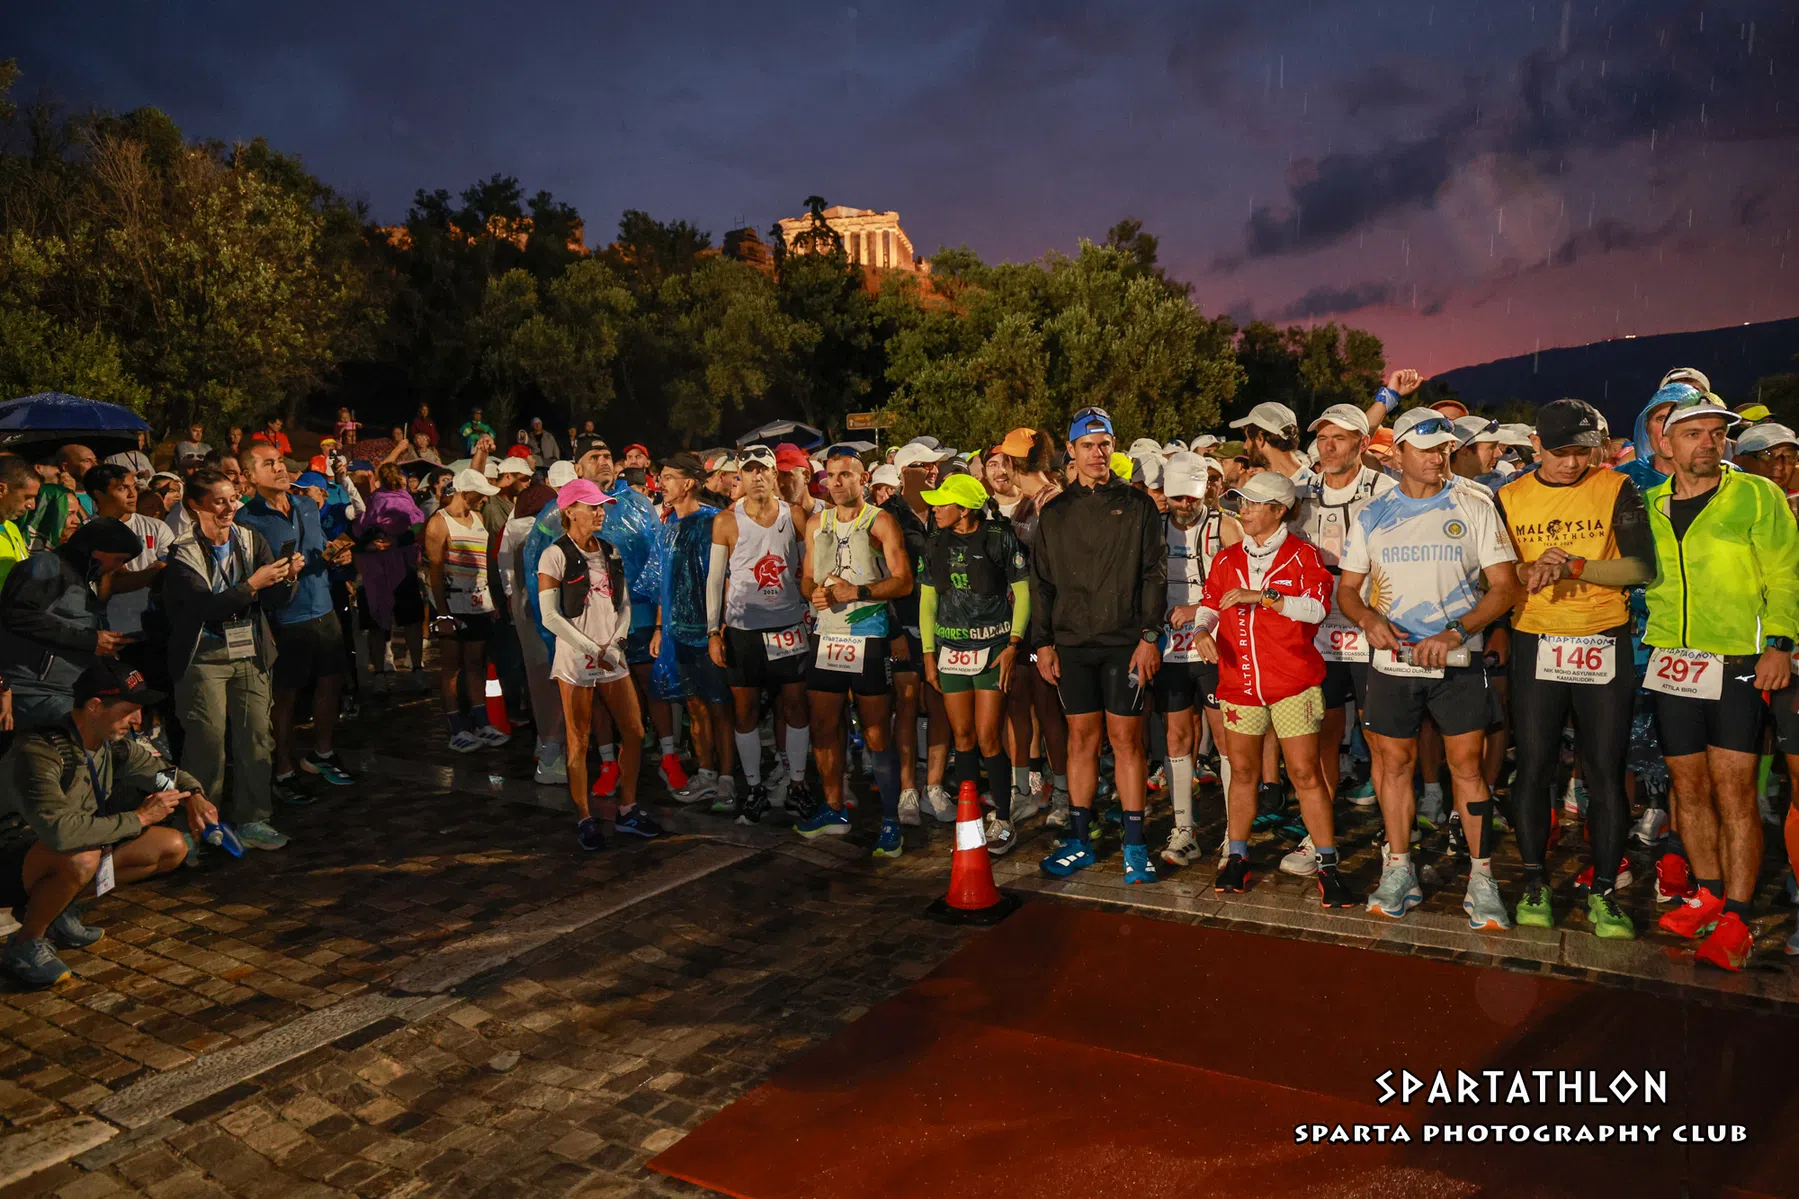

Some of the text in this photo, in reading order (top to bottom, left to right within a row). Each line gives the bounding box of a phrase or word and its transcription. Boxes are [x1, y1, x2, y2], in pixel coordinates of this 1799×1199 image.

[1516, 519, 1604, 536] MALYSIA
[1517, 531, 1605, 543] SPARTATHLON
[1382, 544, 1463, 563] ARGENTINA
[772, 628, 804, 648] 191
[1330, 630, 1358, 650] 92
[826, 642, 856, 663] 173
[947, 650, 979, 665] 361
[1238, 607, 1253, 696] ALTRA RUNN
[1552, 645, 1602, 670] 146
[1657, 656, 1709, 683] 297
[1662, 683, 1680, 691] ATTILA
